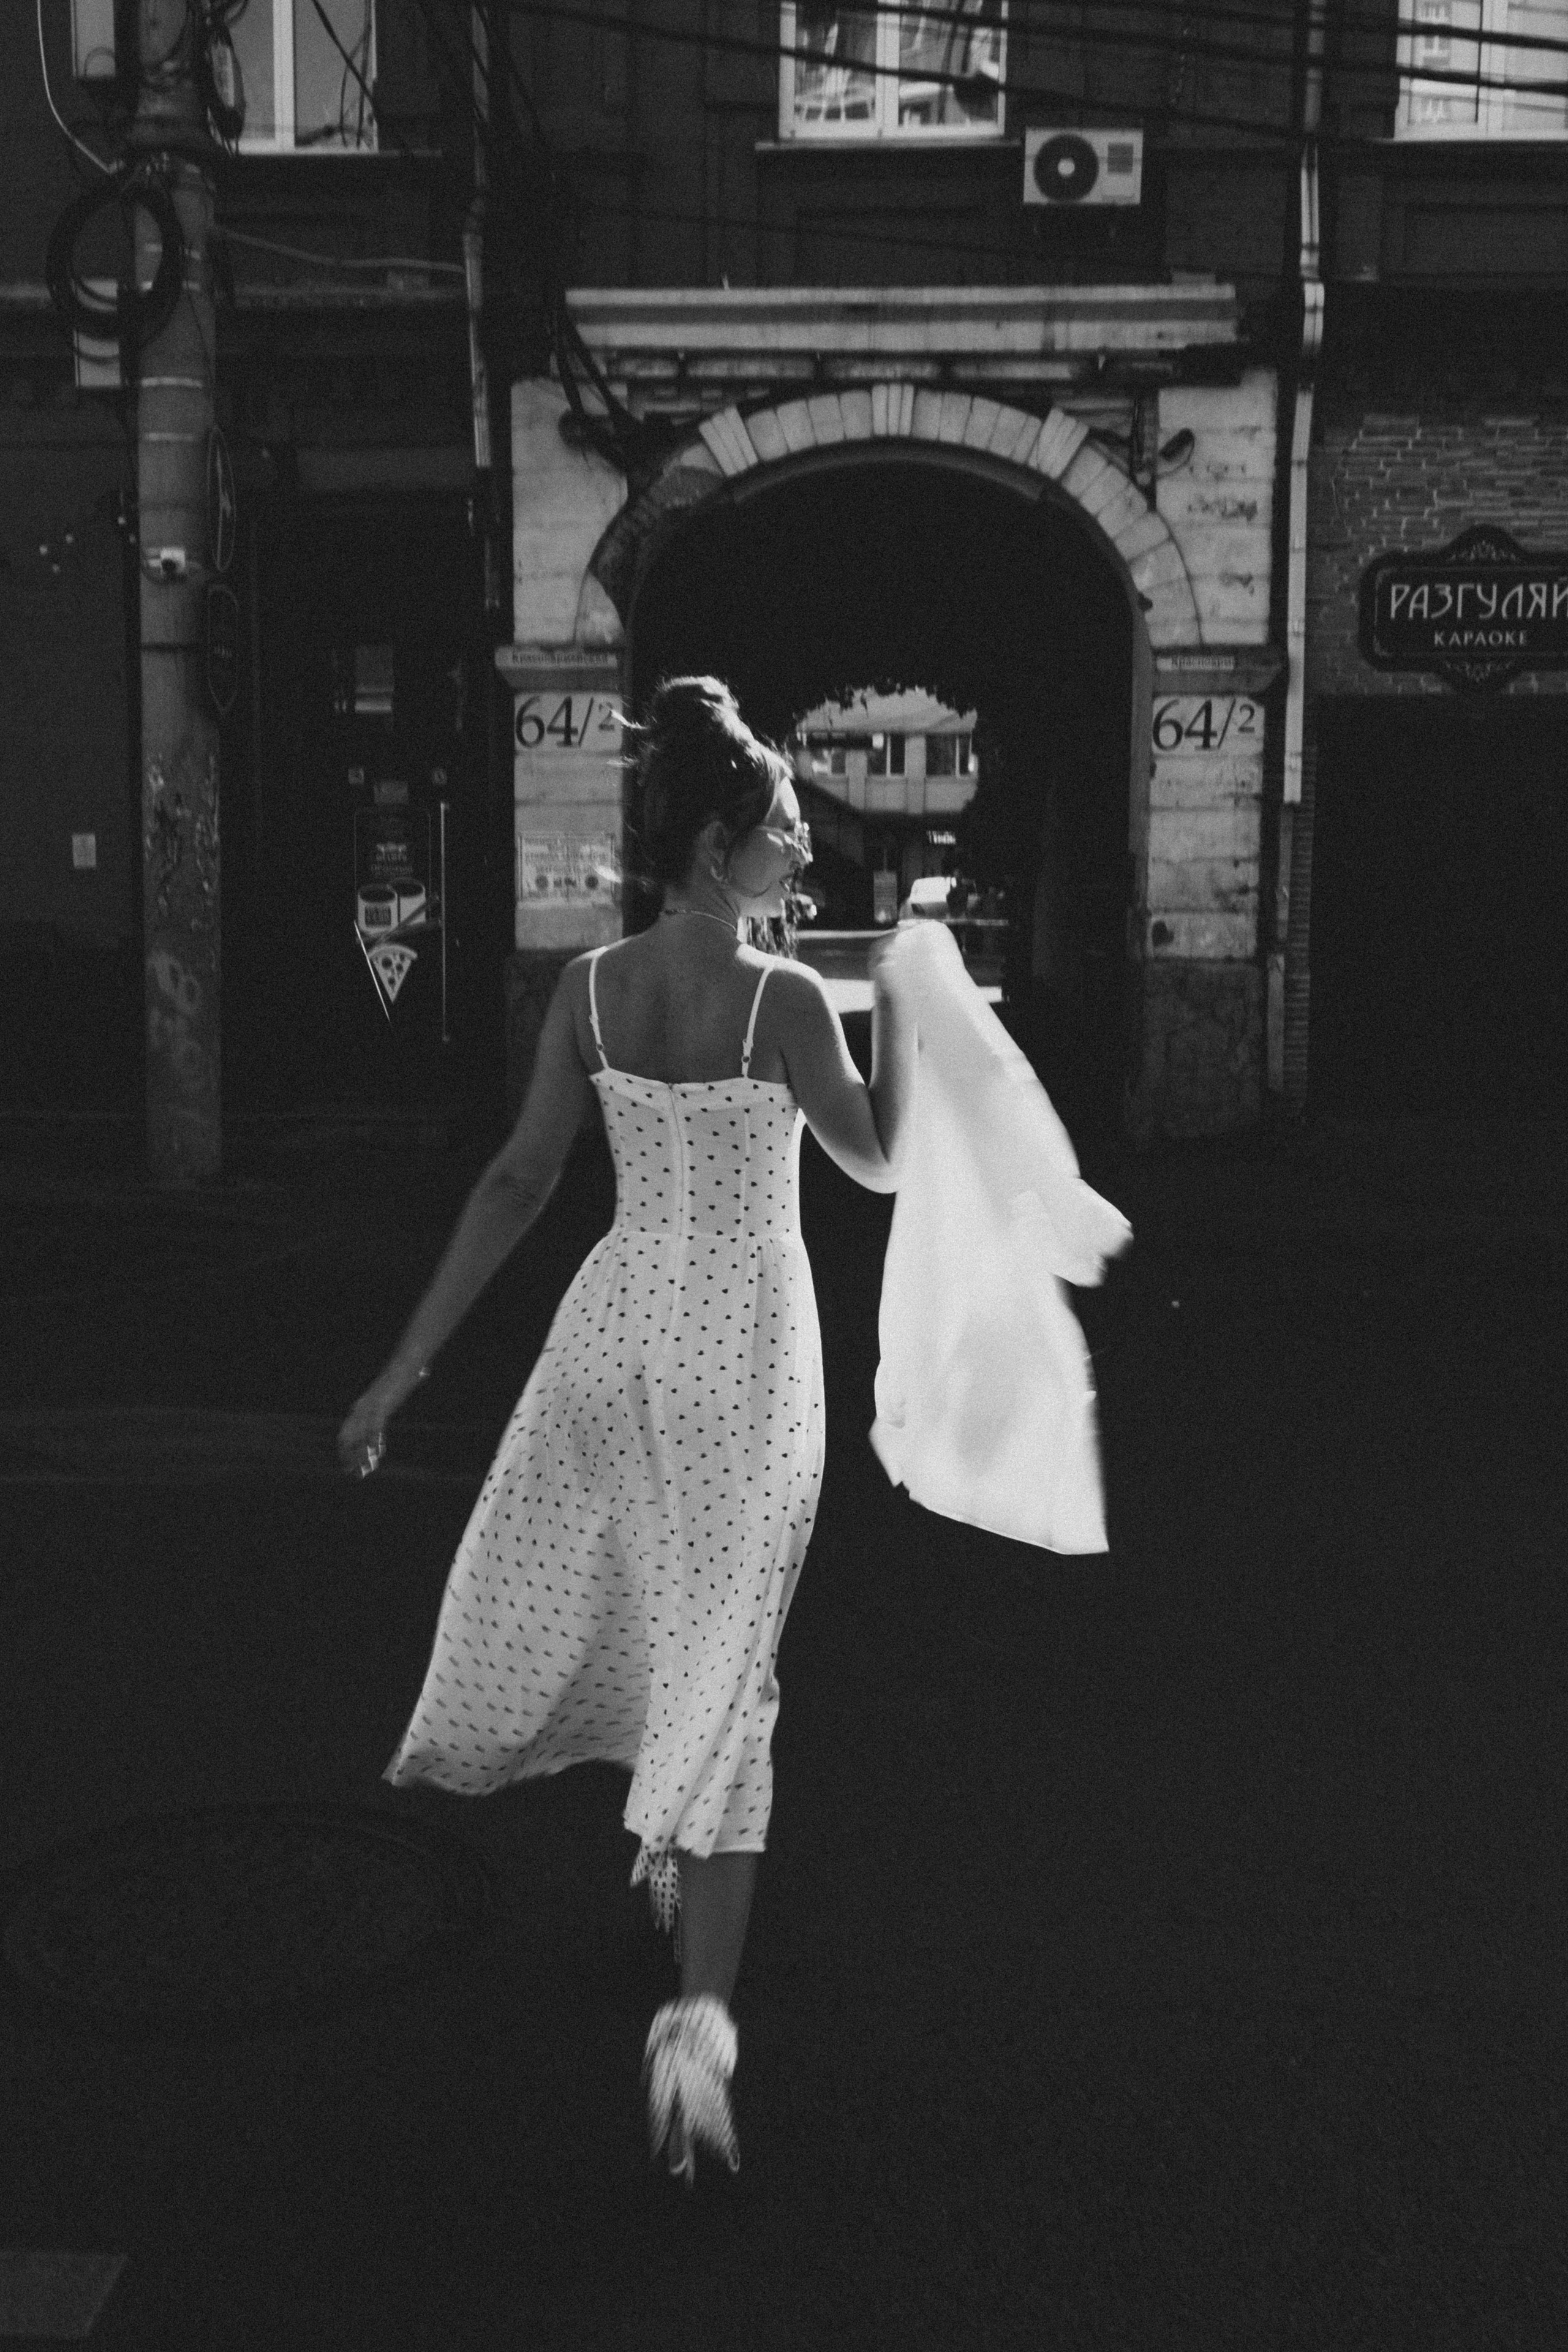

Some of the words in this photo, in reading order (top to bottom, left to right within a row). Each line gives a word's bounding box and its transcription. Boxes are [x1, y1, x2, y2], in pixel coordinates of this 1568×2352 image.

[1434, 631, 1527, 646] КАРАОКЕ
[516, 696, 614, 748] 64/2
[1153, 699, 1256, 751] 64/2
